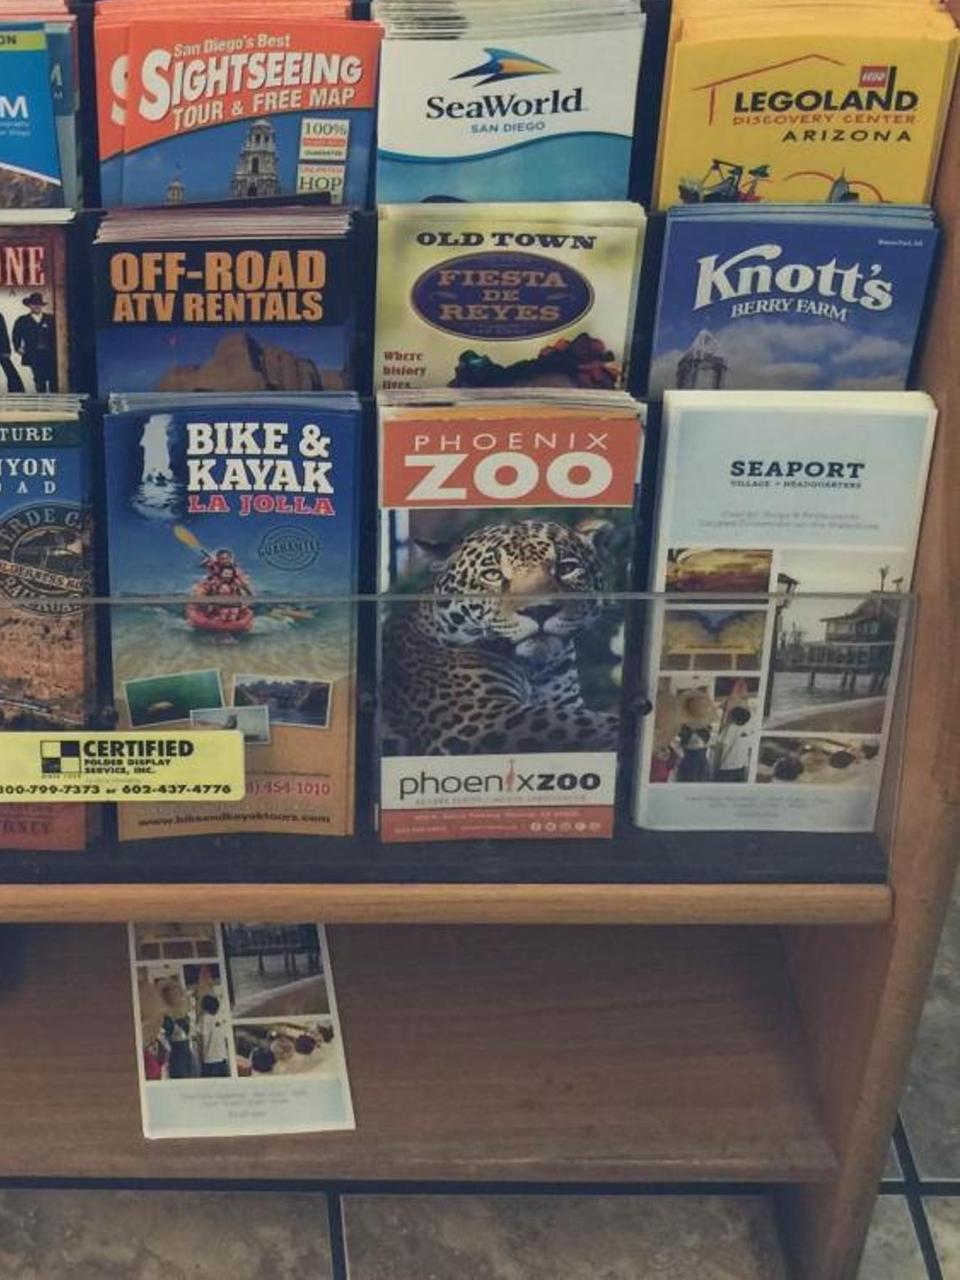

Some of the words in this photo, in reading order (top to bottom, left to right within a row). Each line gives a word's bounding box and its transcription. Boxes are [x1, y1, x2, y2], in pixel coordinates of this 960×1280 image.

[173, 41, 200, 58] San
[204, 35, 255, 56] Diego's
[258, 33, 291, 50] Best
[172, 103, 223, 132] TOUR
[251, 87, 304, 113] FREE
[309, 84, 355, 108] MAP
[425, 87, 584, 121] SeaWorld
[733, 86, 918, 114] LEGOLAND
[470, 123, 500, 134] SAN
[503, 121, 546, 133] DIEGO
[842, 112, 917, 125] CENTER
[782, 129, 912, 143] ARIZONA
[416, 231, 485, 248] OLD
[491, 231, 597, 250] TOWN
[109, 250, 327, 293] OFF-ROAD
[437, 269, 566, 290] FIESTA
[692, 243, 895, 312] Knott's
[113, 293, 175, 322] ATV
[183, 292, 324, 322] RENTALS
[439, 304, 560, 321] REYES
[730, 298, 790, 320] BERRY
[795, 298, 848, 322] FARM
[185, 422, 289, 458] BIKE
[414, 431, 609, 453] PHOENIX
[186, 459, 335, 495] KAYAK
[404, 450, 614, 501] ZOO
[730, 460, 866, 481] SEAPORT
[188, 495, 232, 515] LA
[239, 495, 337, 517] JOLLA
[83, 740, 194, 758] CERTIFIED
[122, 784, 232, 795] 602-437-4776
